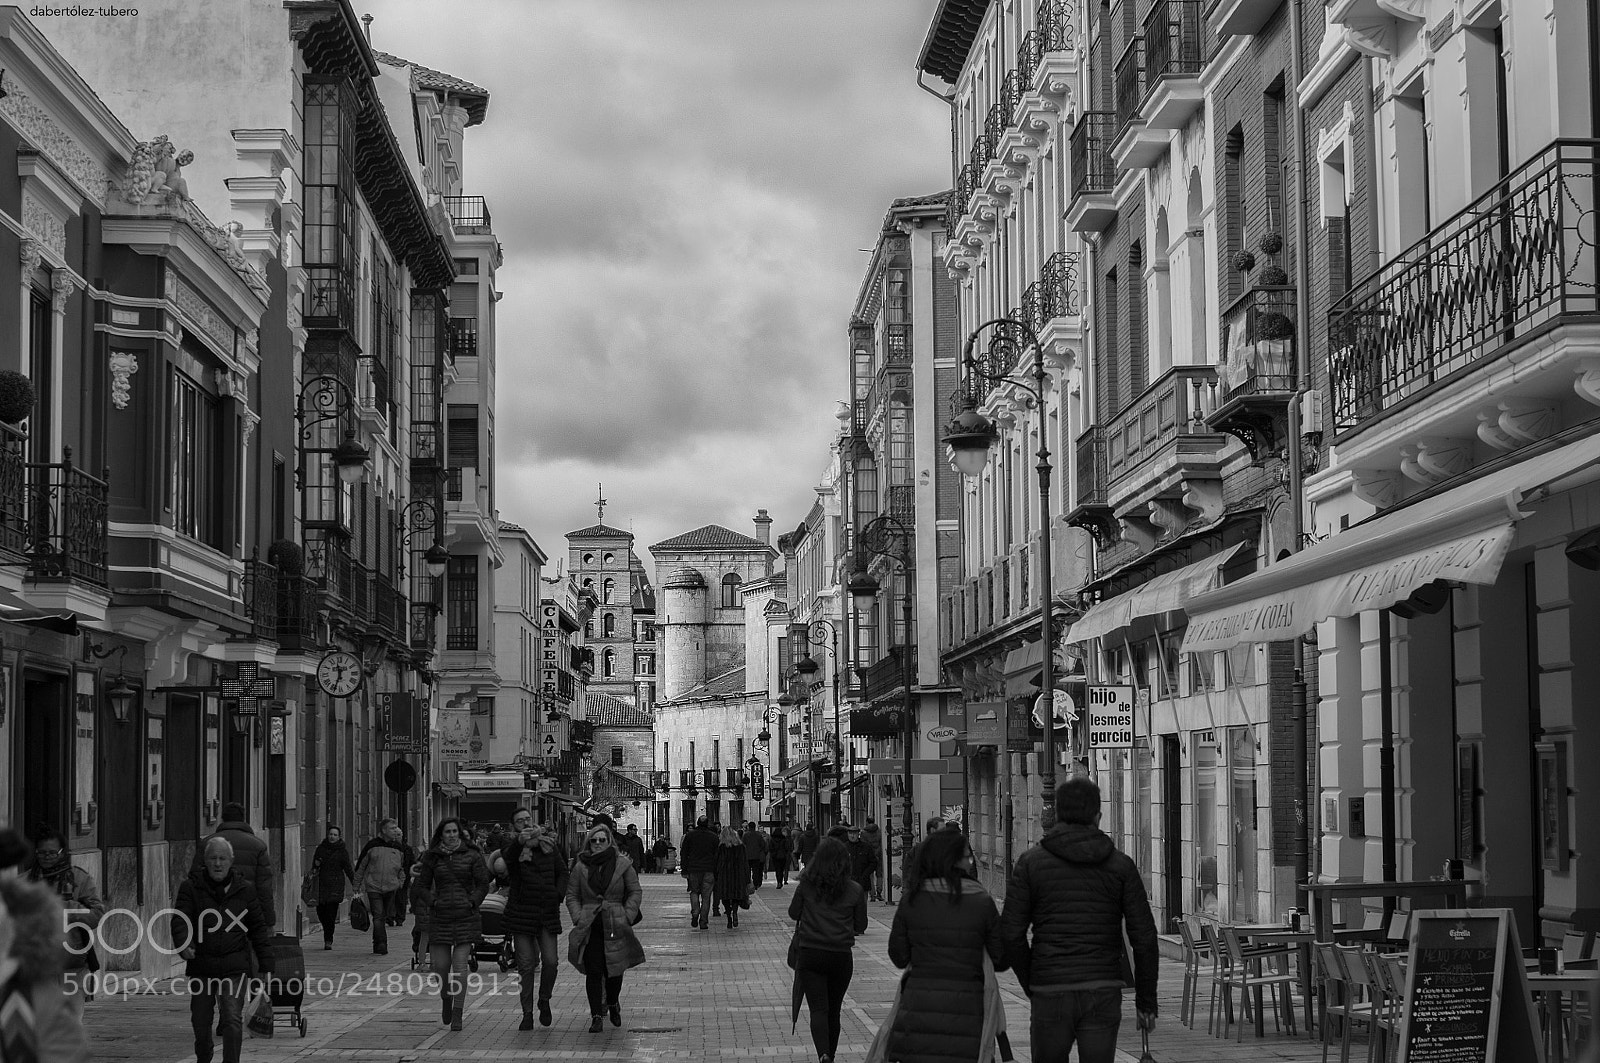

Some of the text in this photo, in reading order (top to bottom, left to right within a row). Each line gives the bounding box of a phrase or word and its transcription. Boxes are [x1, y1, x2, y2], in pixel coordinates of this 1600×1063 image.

[543, 606, 557, 744] CAFETERIA
[1090, 688, 1117, 707] hijo
[1118, 701, 1131, 712] de
[383, 695, 391, 750] OPTICA
[421, 702, 430, 754] OPTICA
[1090, 713, 1132, 726] lesmes
[930, 729, 955, 739] VALOR
[1090, 728, 1132, 746] garcía
[752, 764, 762, 795] HOTEL
[1448, 929, 1471, 938] Estrella
